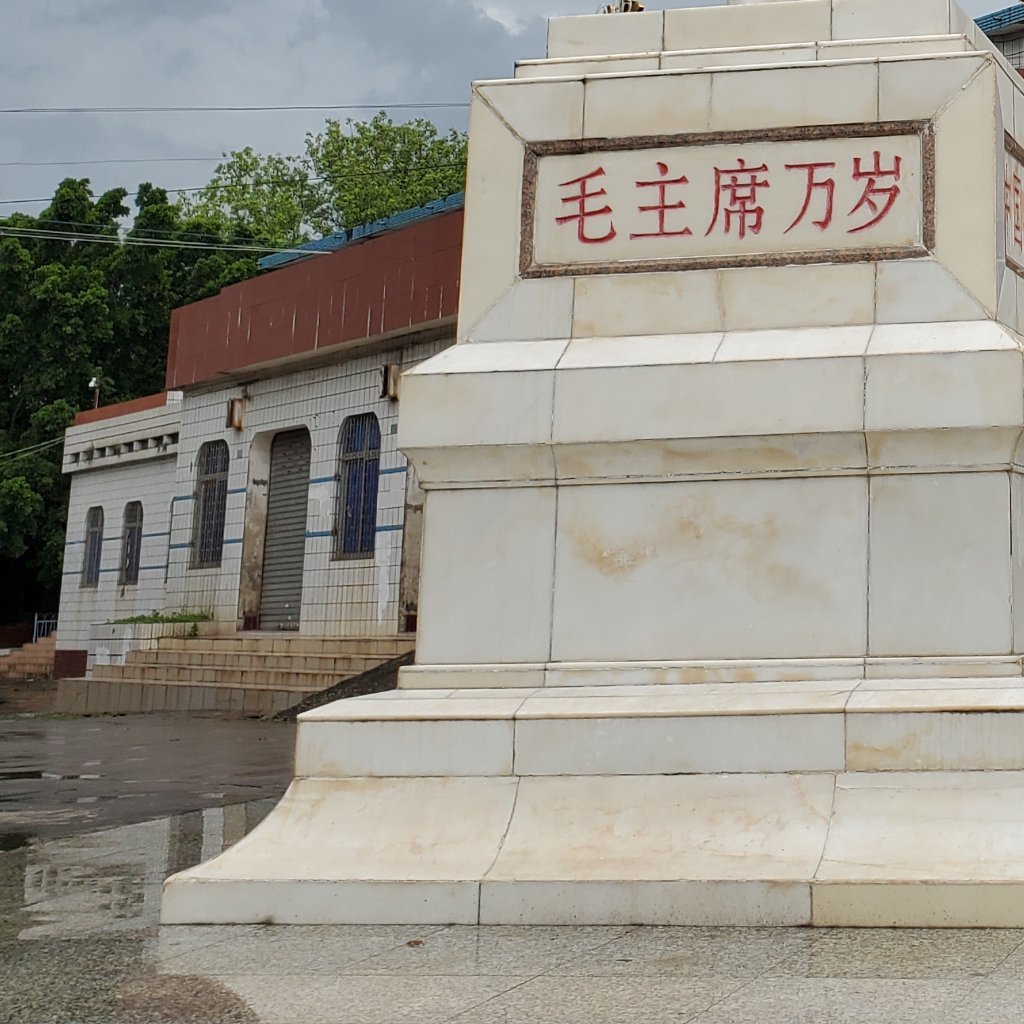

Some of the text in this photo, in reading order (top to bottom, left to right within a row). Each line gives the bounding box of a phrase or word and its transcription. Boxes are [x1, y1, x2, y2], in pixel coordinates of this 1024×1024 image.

[555, 150, 902, 245] 毛主席万岁
